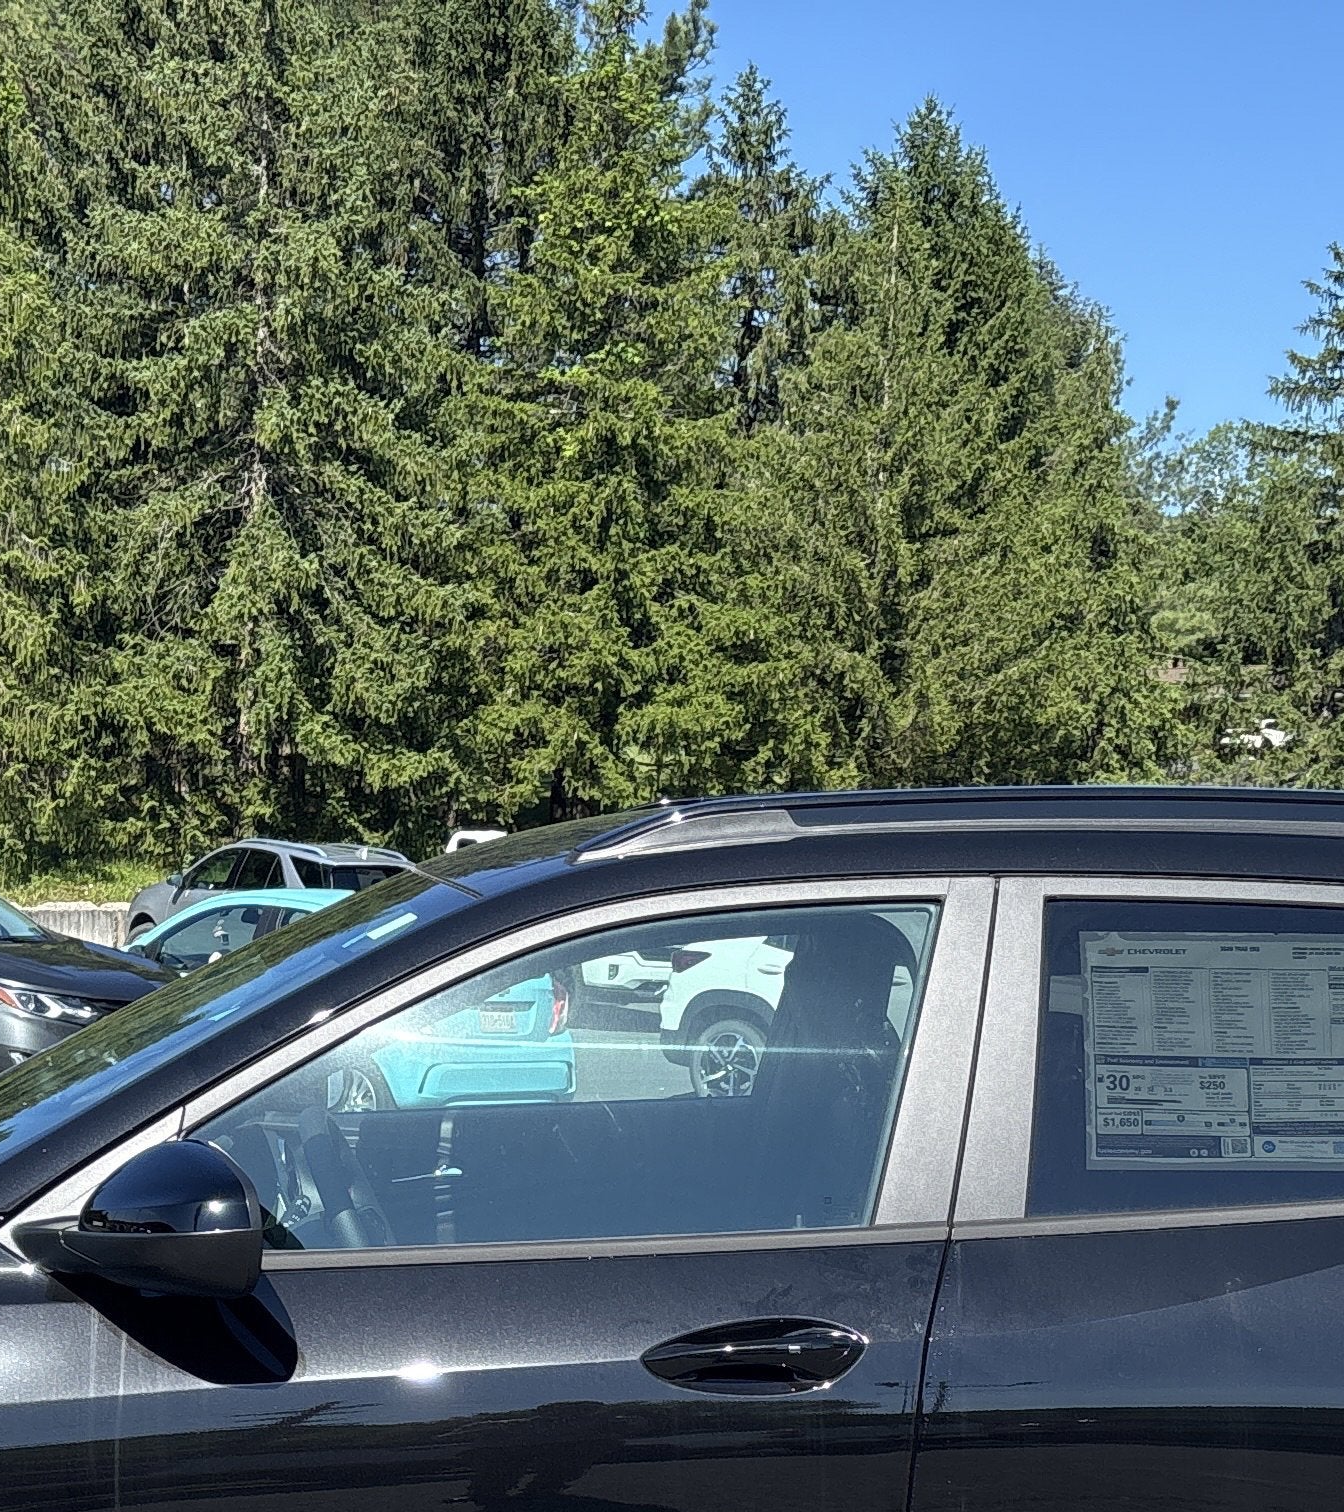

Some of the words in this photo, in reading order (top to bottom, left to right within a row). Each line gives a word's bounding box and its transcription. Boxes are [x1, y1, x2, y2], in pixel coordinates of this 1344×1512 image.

[1106, 1074, 1130, 1091] 30
[1199, 1080, 1226, 1091] $250
[1103, 1117, 1140, 1129] $1,650
